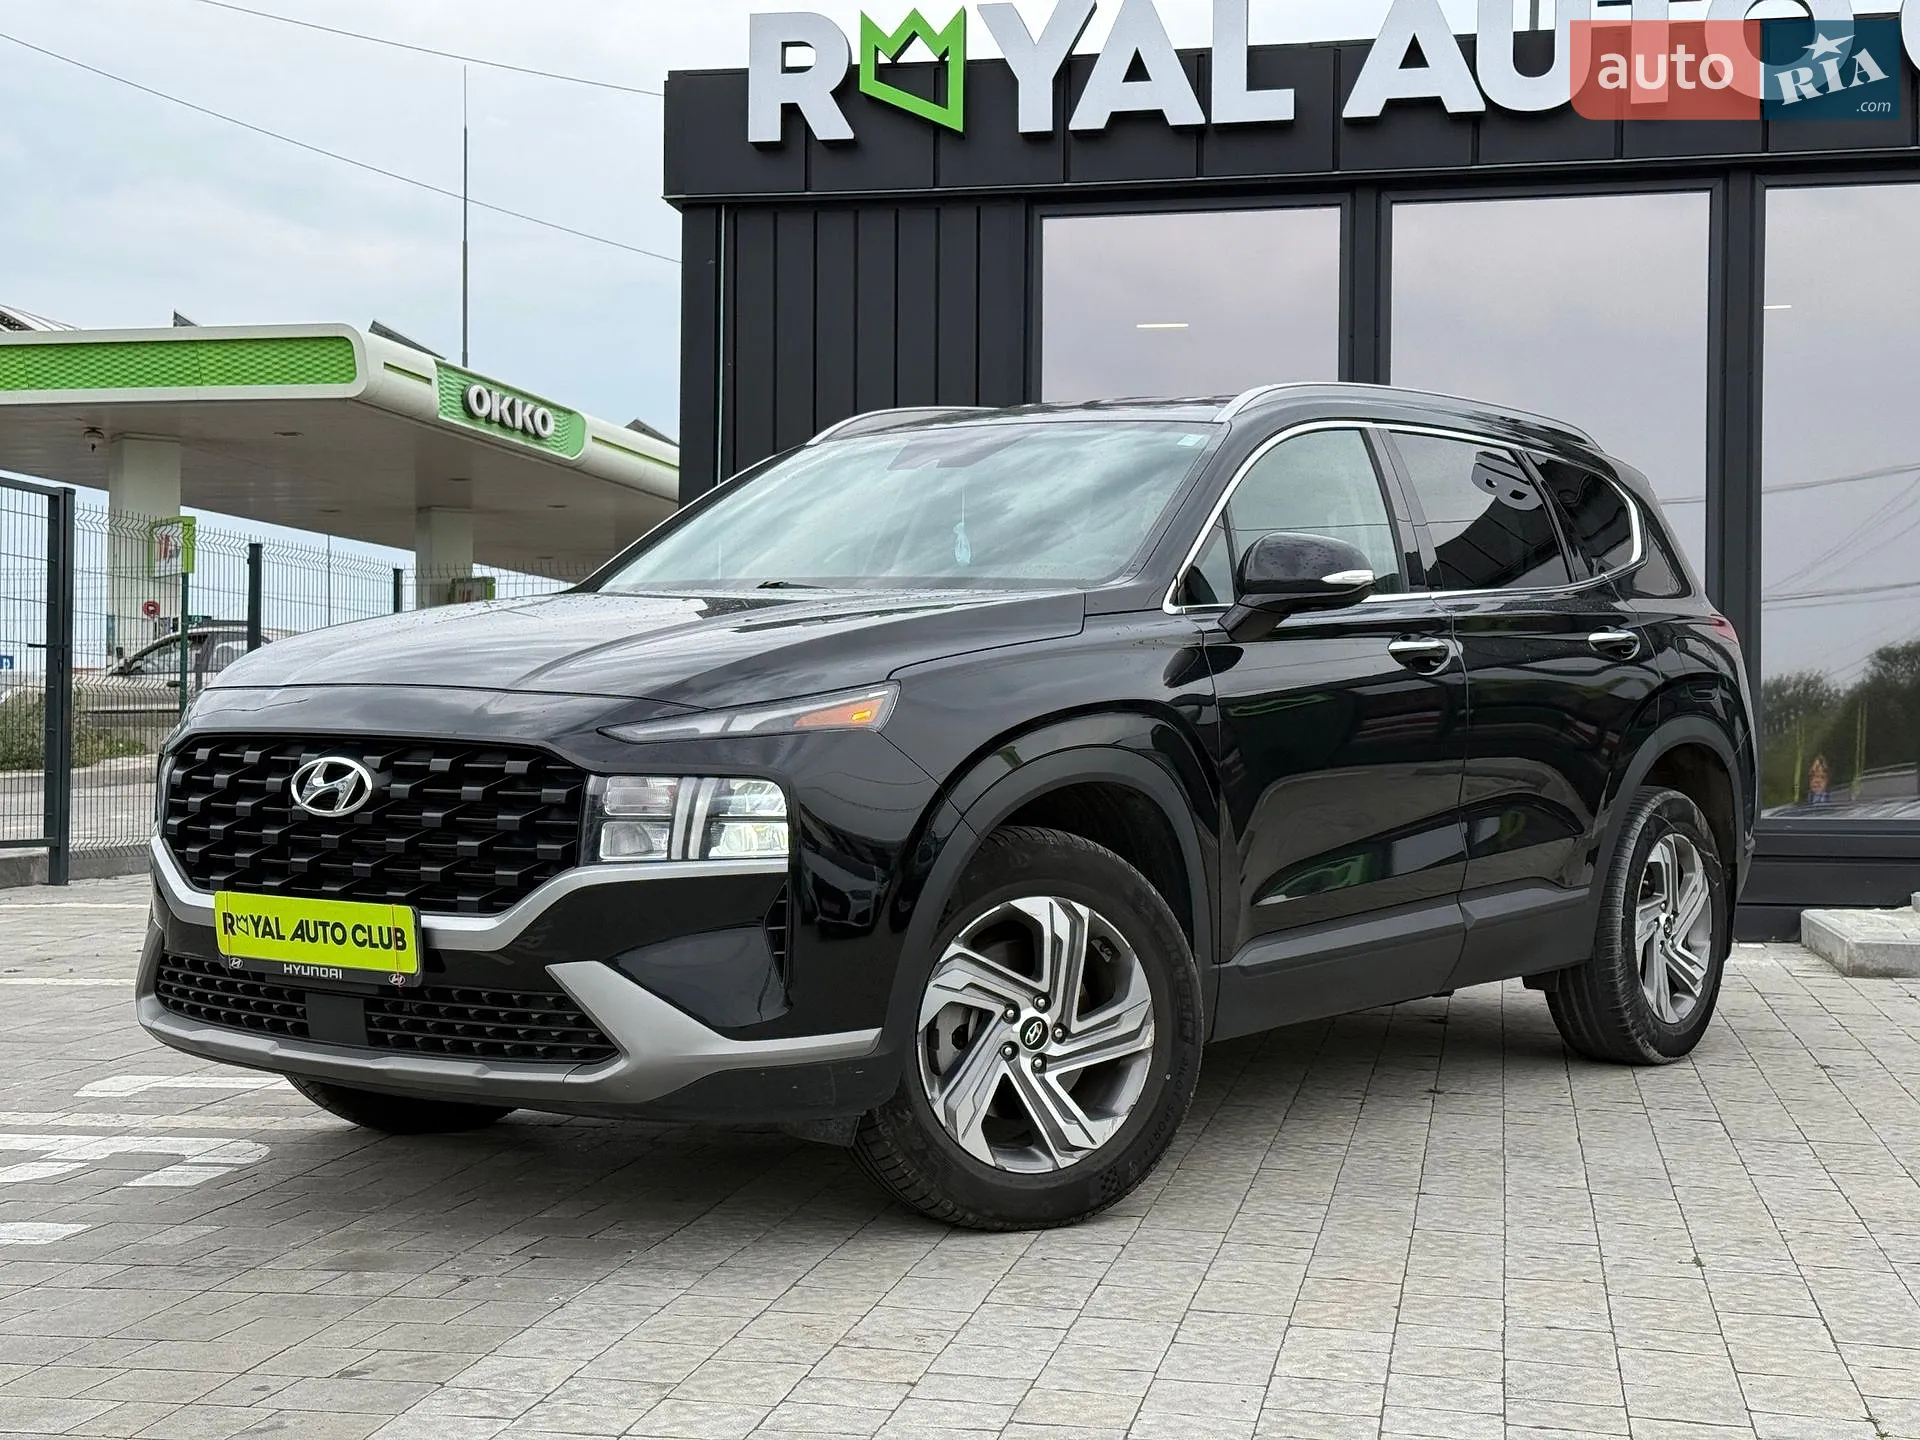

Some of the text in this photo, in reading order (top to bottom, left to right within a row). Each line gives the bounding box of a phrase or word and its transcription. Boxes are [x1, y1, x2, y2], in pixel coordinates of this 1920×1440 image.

[1342, 0, 1855, 122] AUTO
[465, 384, 555, 438] OKKO
[289, 919, 347, 945] AUTO
[351, 924, 407, 951] CLUB
[283, 963, 343, 980] HYUNDAI
